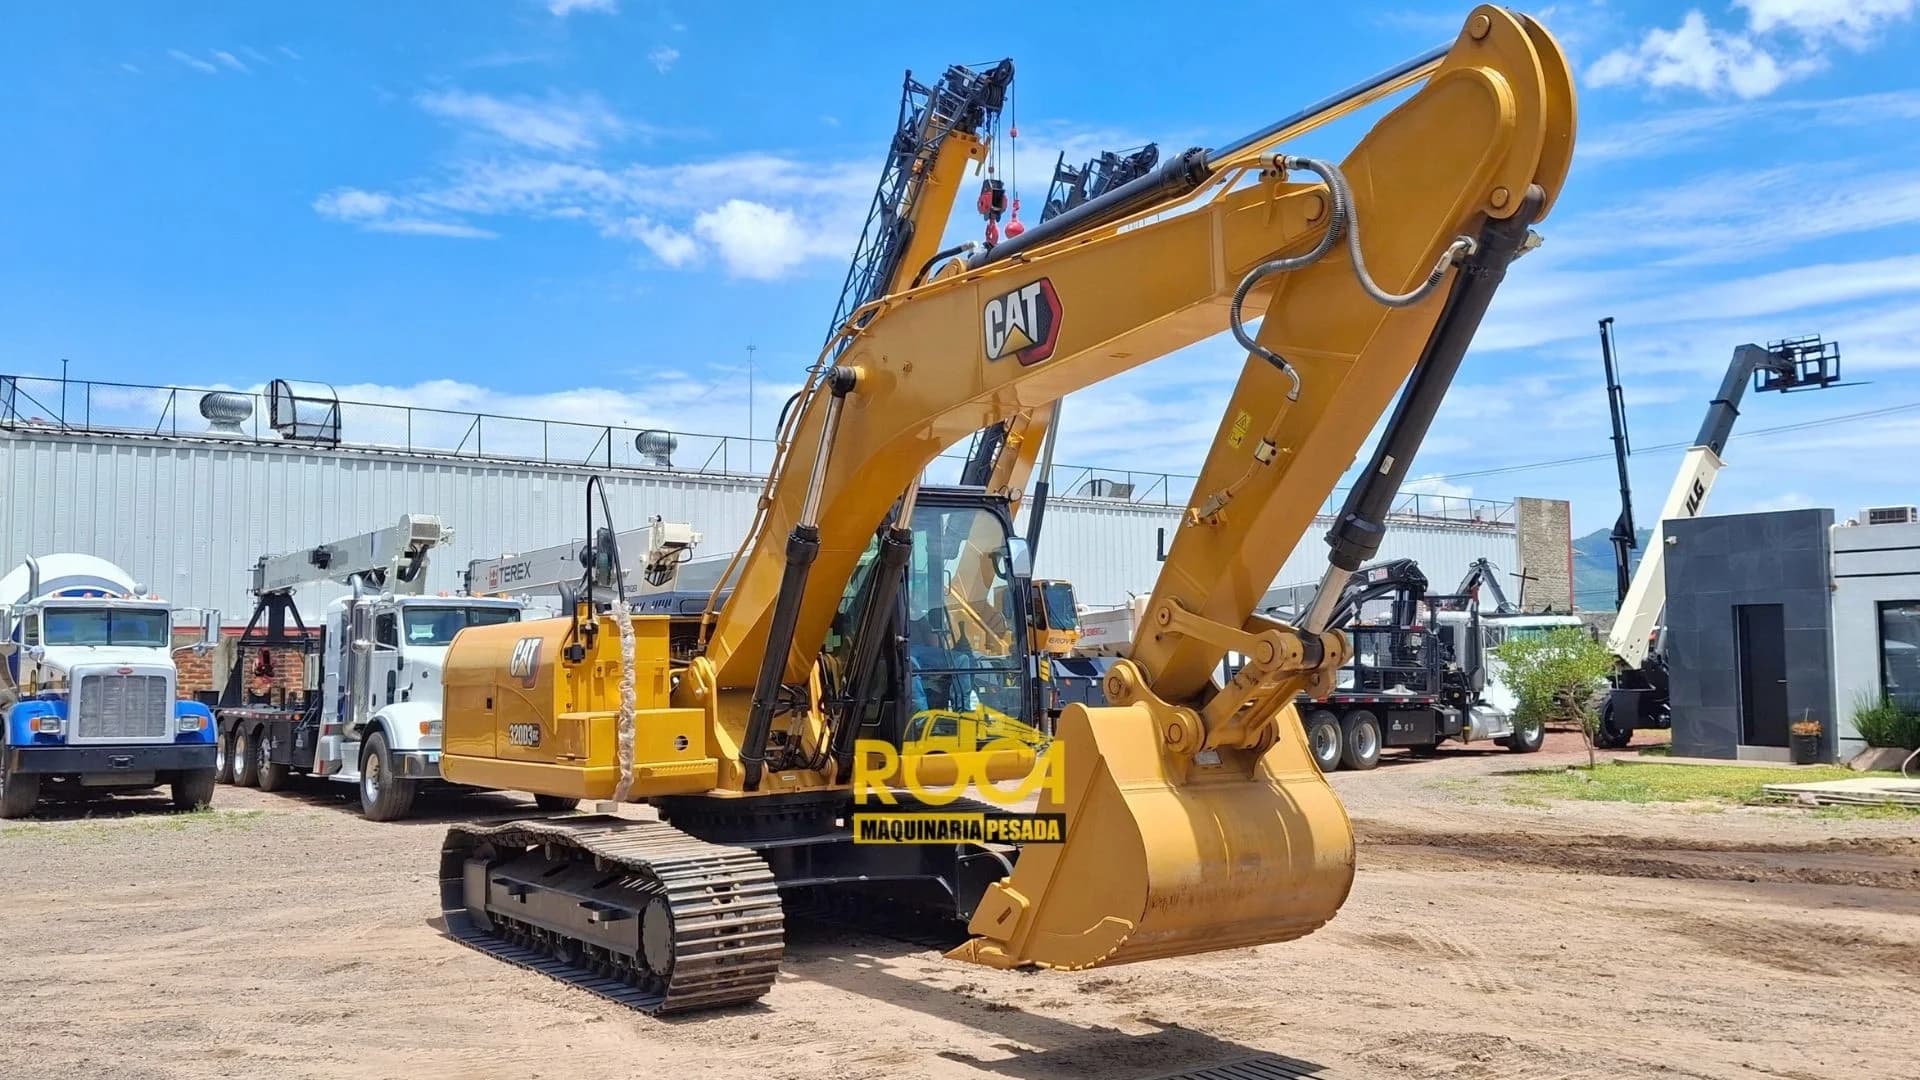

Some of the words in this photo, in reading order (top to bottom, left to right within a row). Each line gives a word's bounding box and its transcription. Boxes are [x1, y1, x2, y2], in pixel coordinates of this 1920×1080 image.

[985, 281, 1040, 359] CAT
[499, 561, 531, 585] TEREX
[511, 638, 542, 676] CAT
